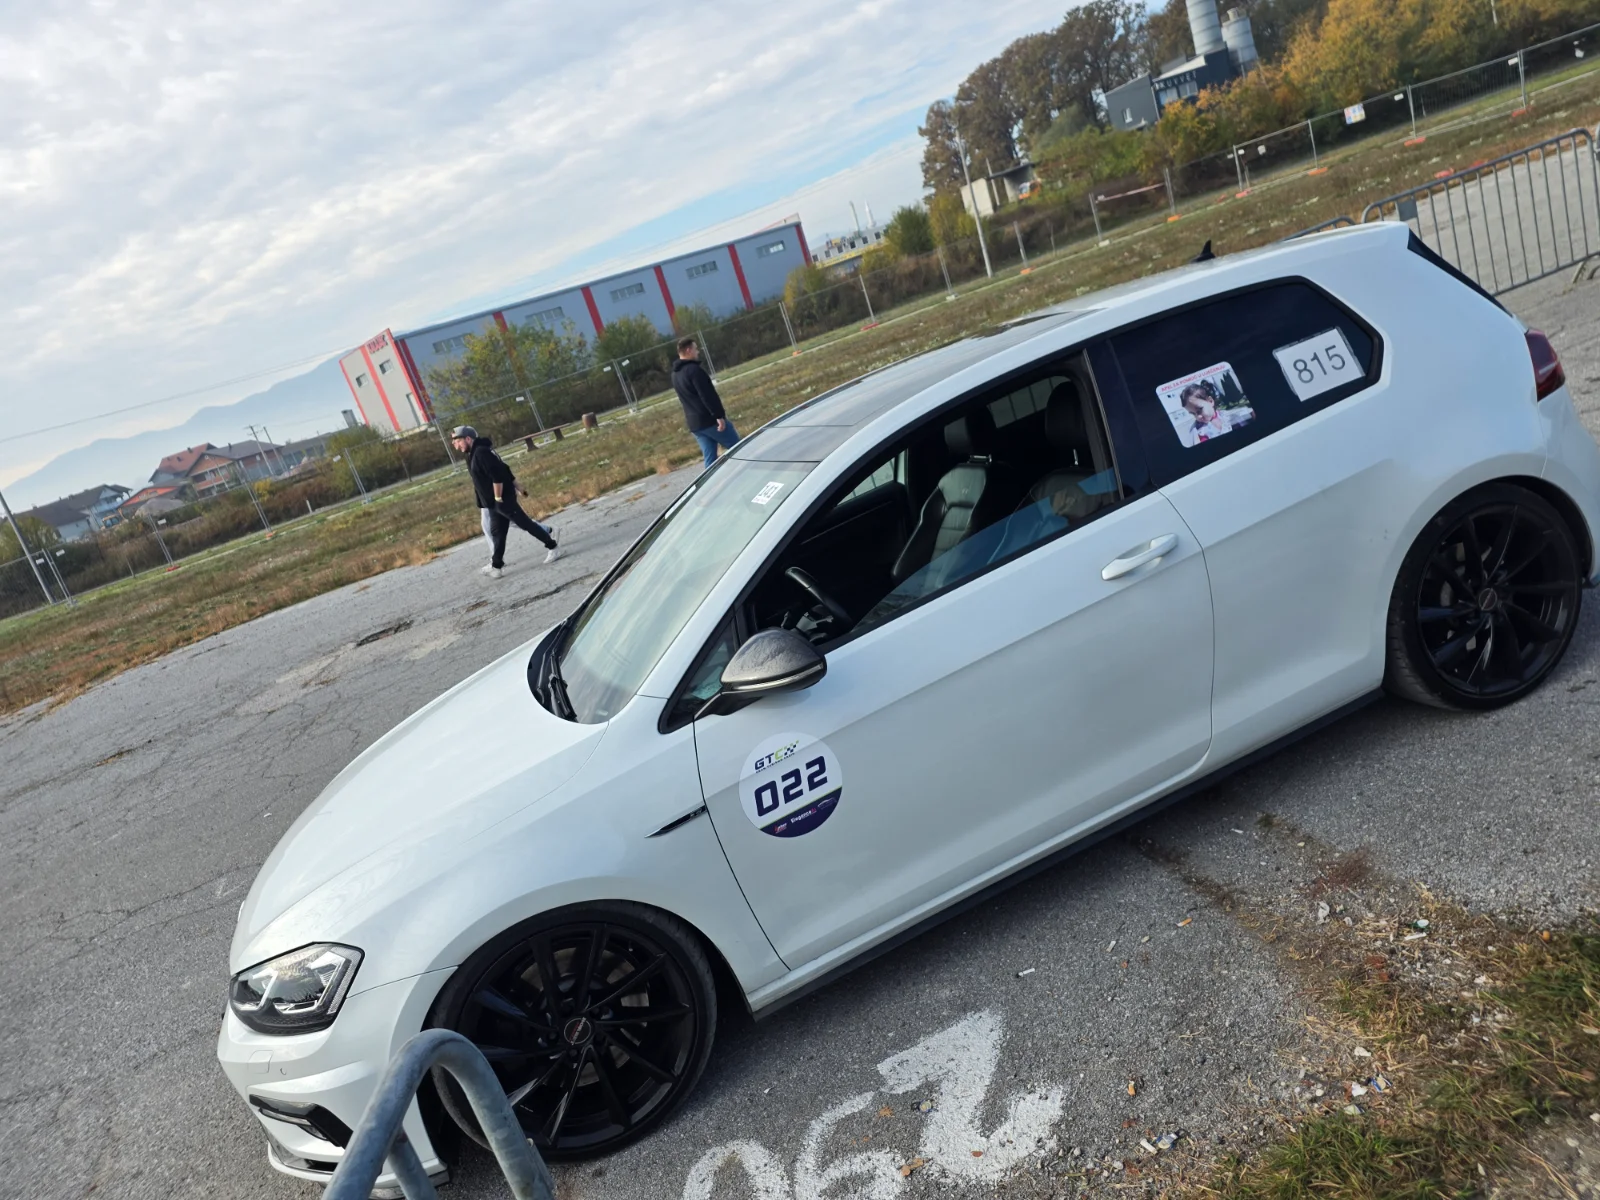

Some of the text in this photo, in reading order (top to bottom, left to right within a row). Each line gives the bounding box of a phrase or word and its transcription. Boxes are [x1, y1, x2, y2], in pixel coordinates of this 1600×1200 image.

[1292, 344, 1346, 384] 815
[755, 748, 783, 770] GTC
[754, 756, 828, 817] 022
